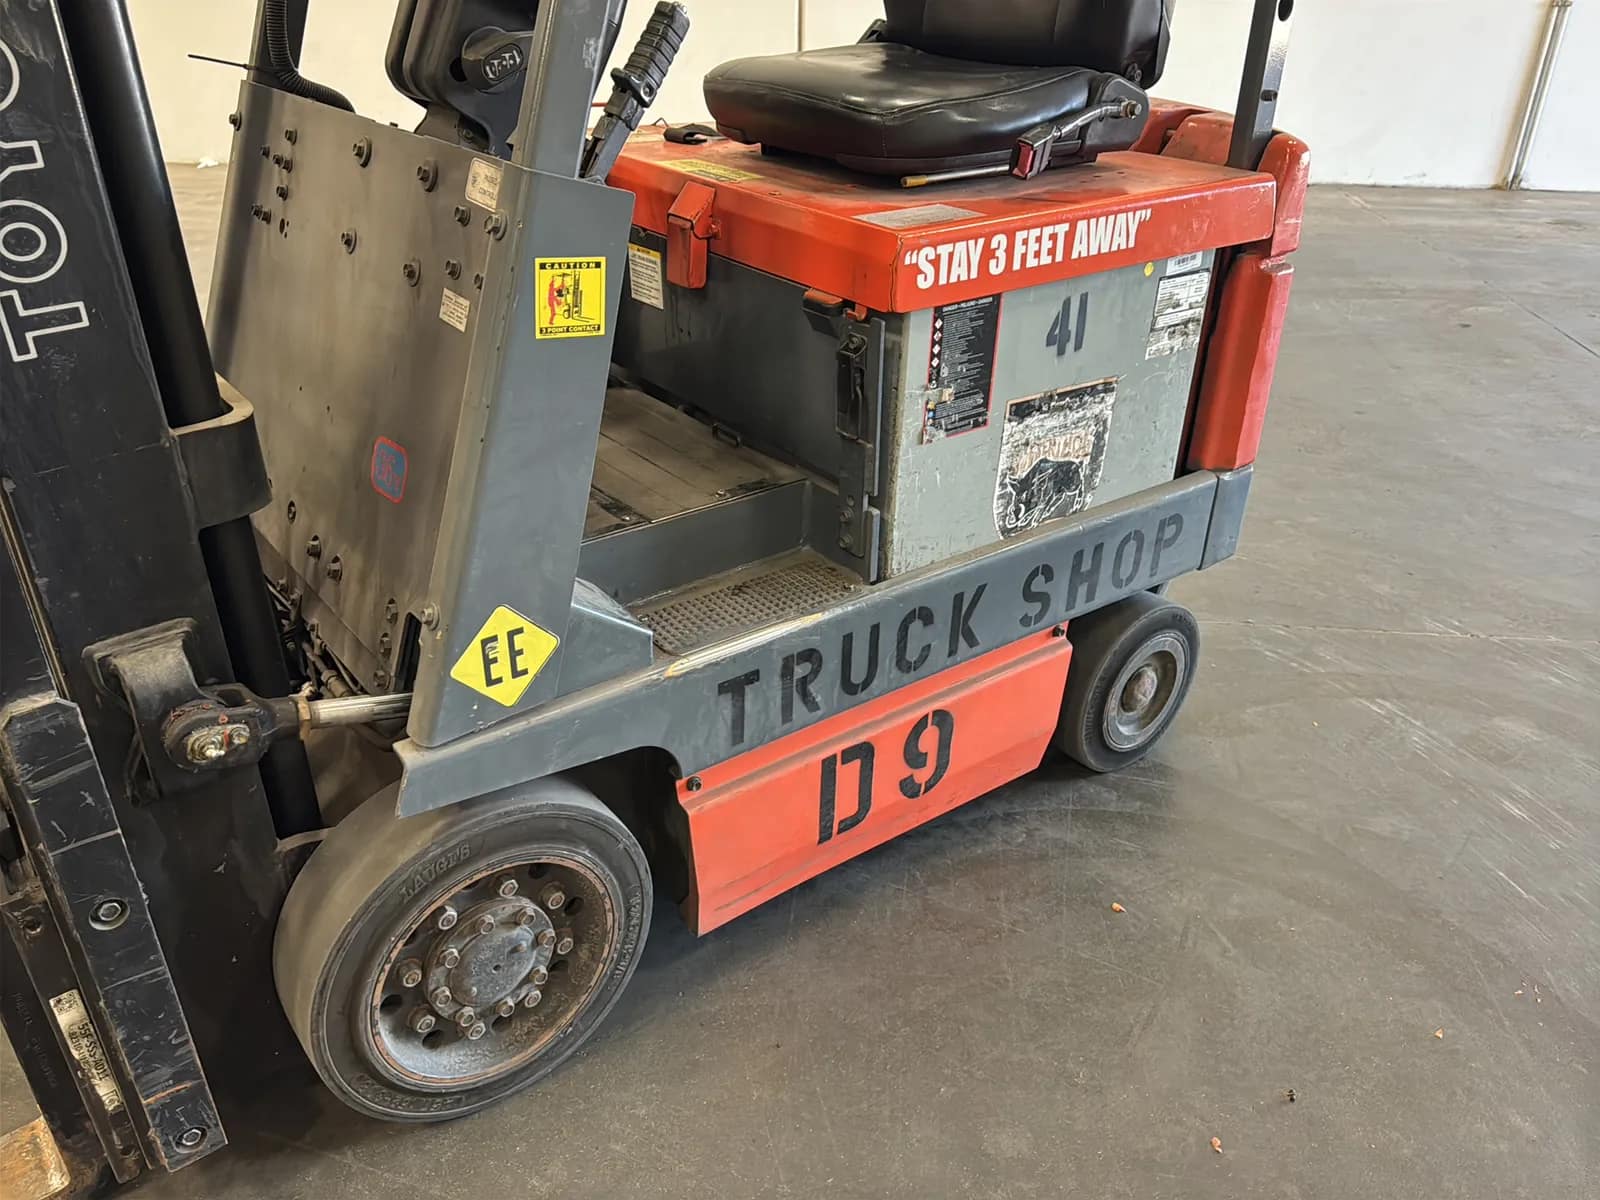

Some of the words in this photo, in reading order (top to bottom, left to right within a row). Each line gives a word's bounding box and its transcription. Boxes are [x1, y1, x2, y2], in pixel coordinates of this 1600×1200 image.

[545, 262, 596, 270] CAUTION
[989, 234, 1008, 275] 3
[1012, 223, 1070, 271] FEET
[1046, 292, 1089, 356] 41
[480, 626, 528, 687] EE
[717, 582, 988, 746] TRUCK
[1018, 512, 1185, 628] SHOP
